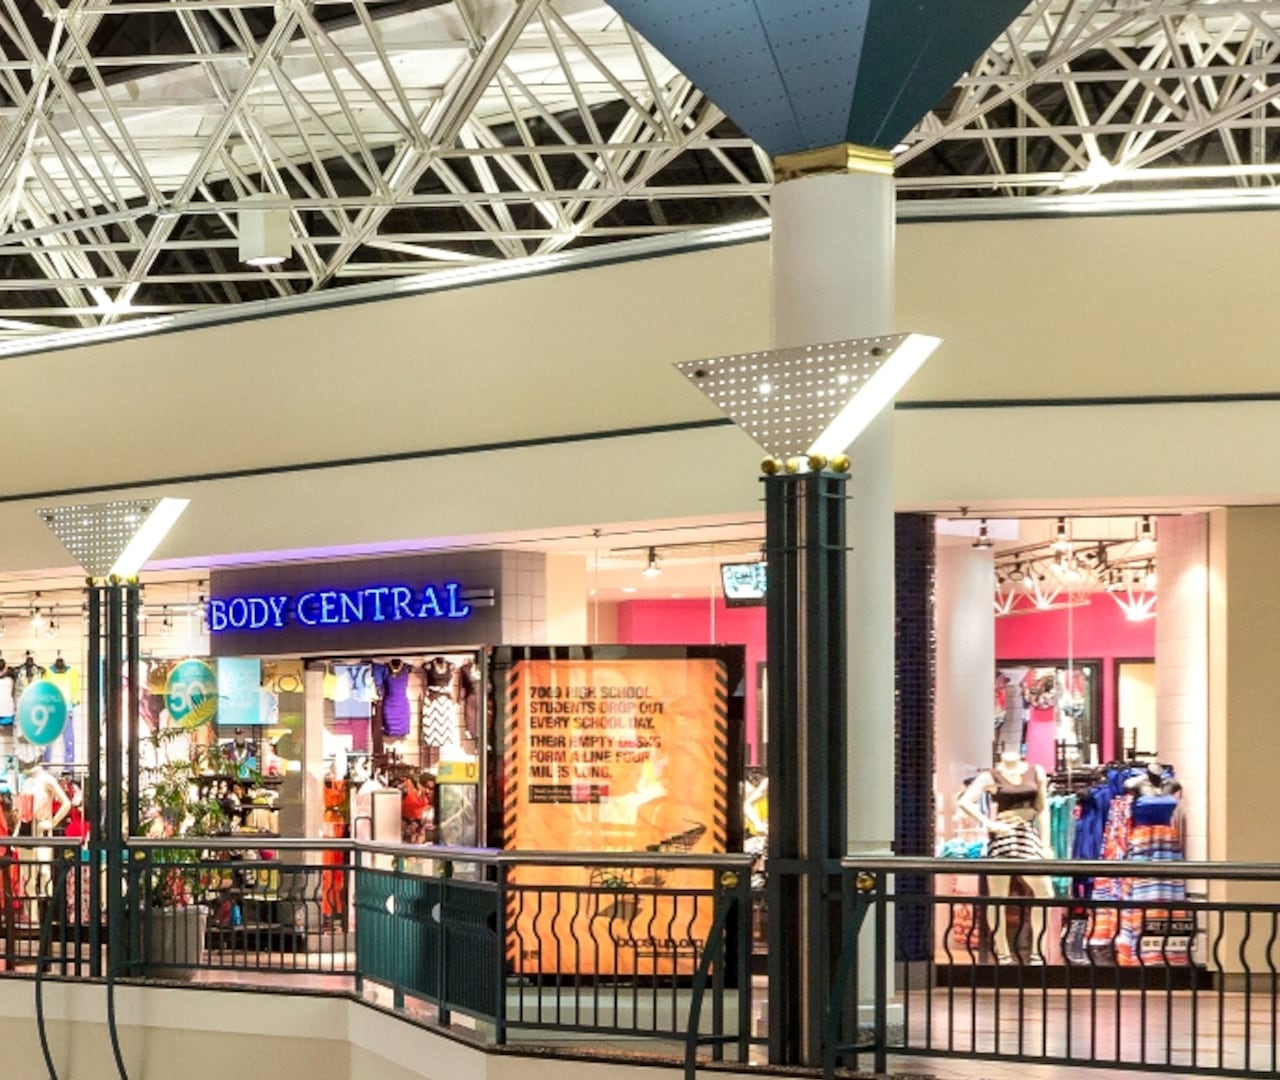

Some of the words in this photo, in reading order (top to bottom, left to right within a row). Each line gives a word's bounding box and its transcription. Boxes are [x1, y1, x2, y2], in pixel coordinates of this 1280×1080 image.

[209, 596, 288, 631] BODY
[297, 583, 470, 626] CENTRAL
[565, 686, 596, 698] HIGH
[600, 686, 651, 698] SCHOOL
[530, 701, 596, 713] STUDENTS
[600, 701, 635, 713] DROP
[639, 701, 664, 713] OUT
[530, 717, 569, 729] EVERY
[573, 717, 625, 729] SCHOOL
[530, 736, 566, 748] THEIR
[570, 736, 615, 748] EMPTY
[530, 751, 567, 763] FORM
[571, 751, 579, 763] A
[583, 751, 612, 763] LINE
[530, 766, 570, 778] MILES
